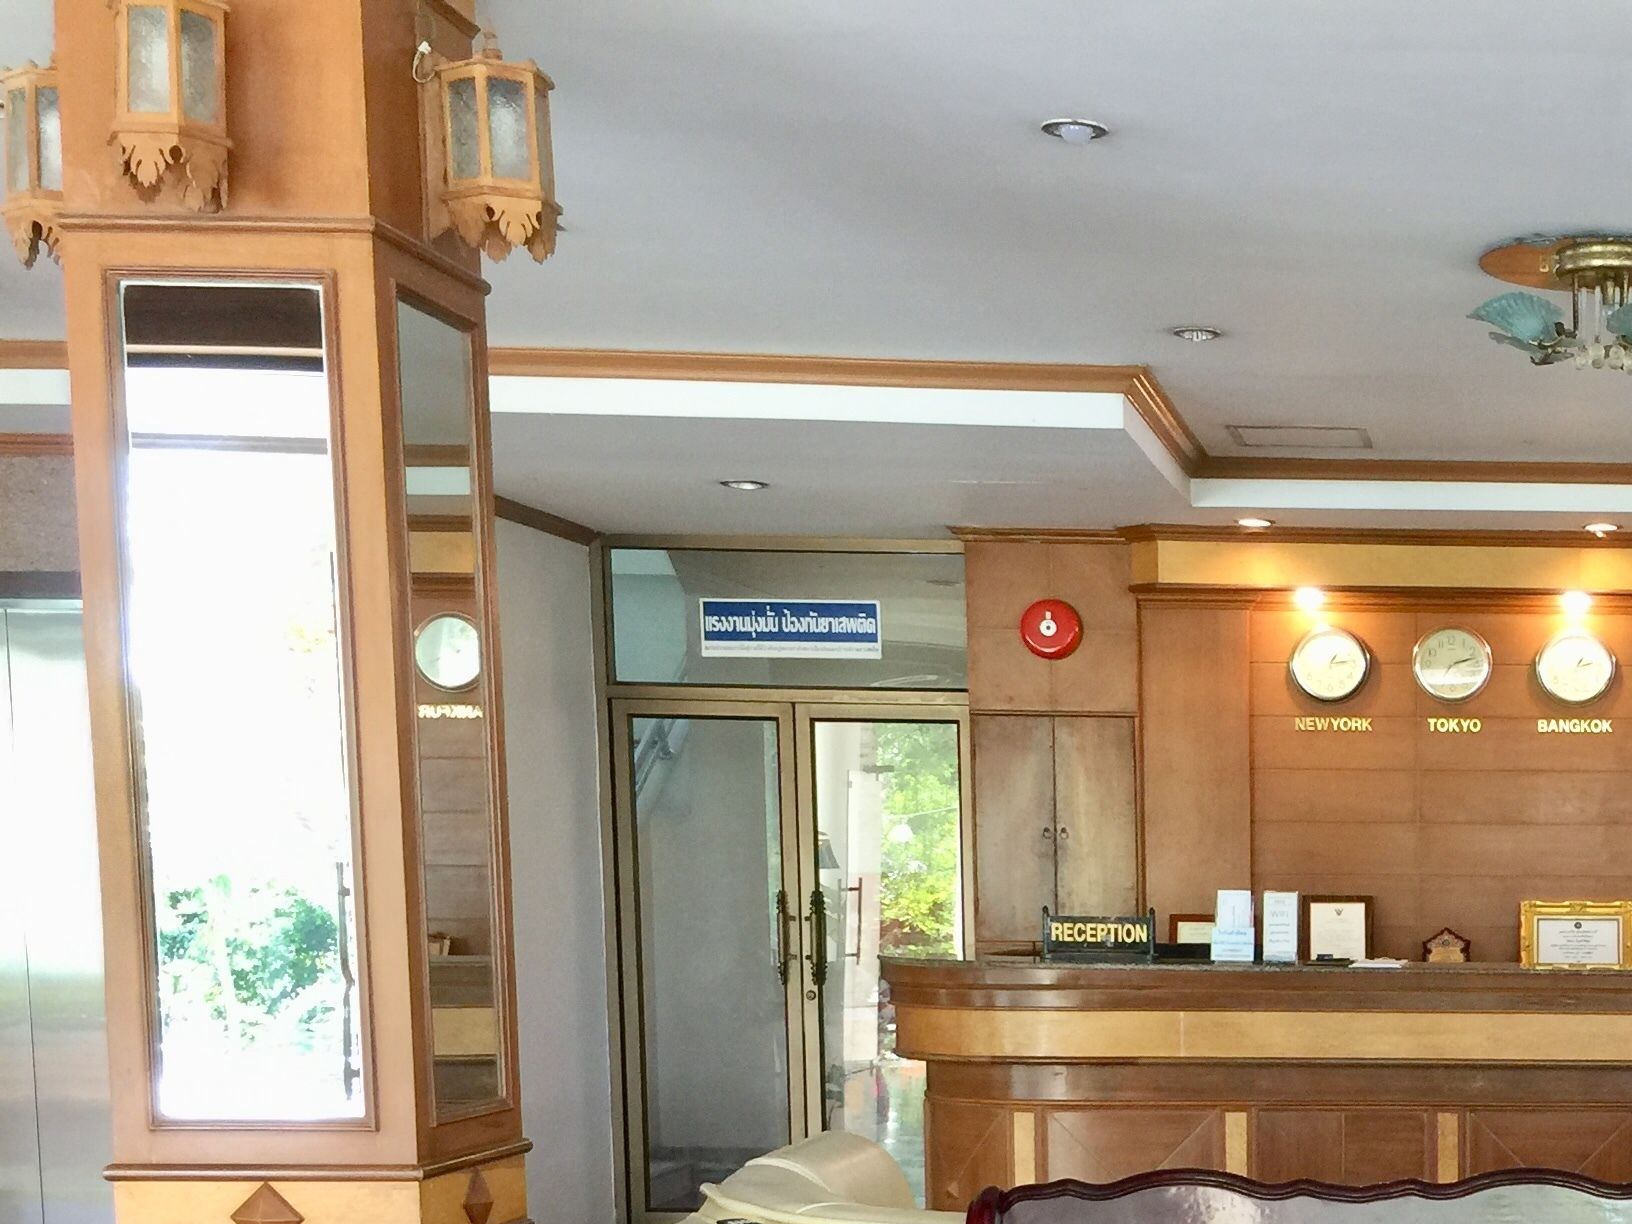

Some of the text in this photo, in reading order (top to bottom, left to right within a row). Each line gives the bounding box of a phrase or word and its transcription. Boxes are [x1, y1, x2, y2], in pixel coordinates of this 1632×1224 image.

[782, 609, 876, 634] ป้องกันยาเสพติด
[1427, 718, 1482, 733] TOKYO
[1537, 719, 1613, 733] BANGKOK
[1051, 922, 1148, 943] RECEPTION
